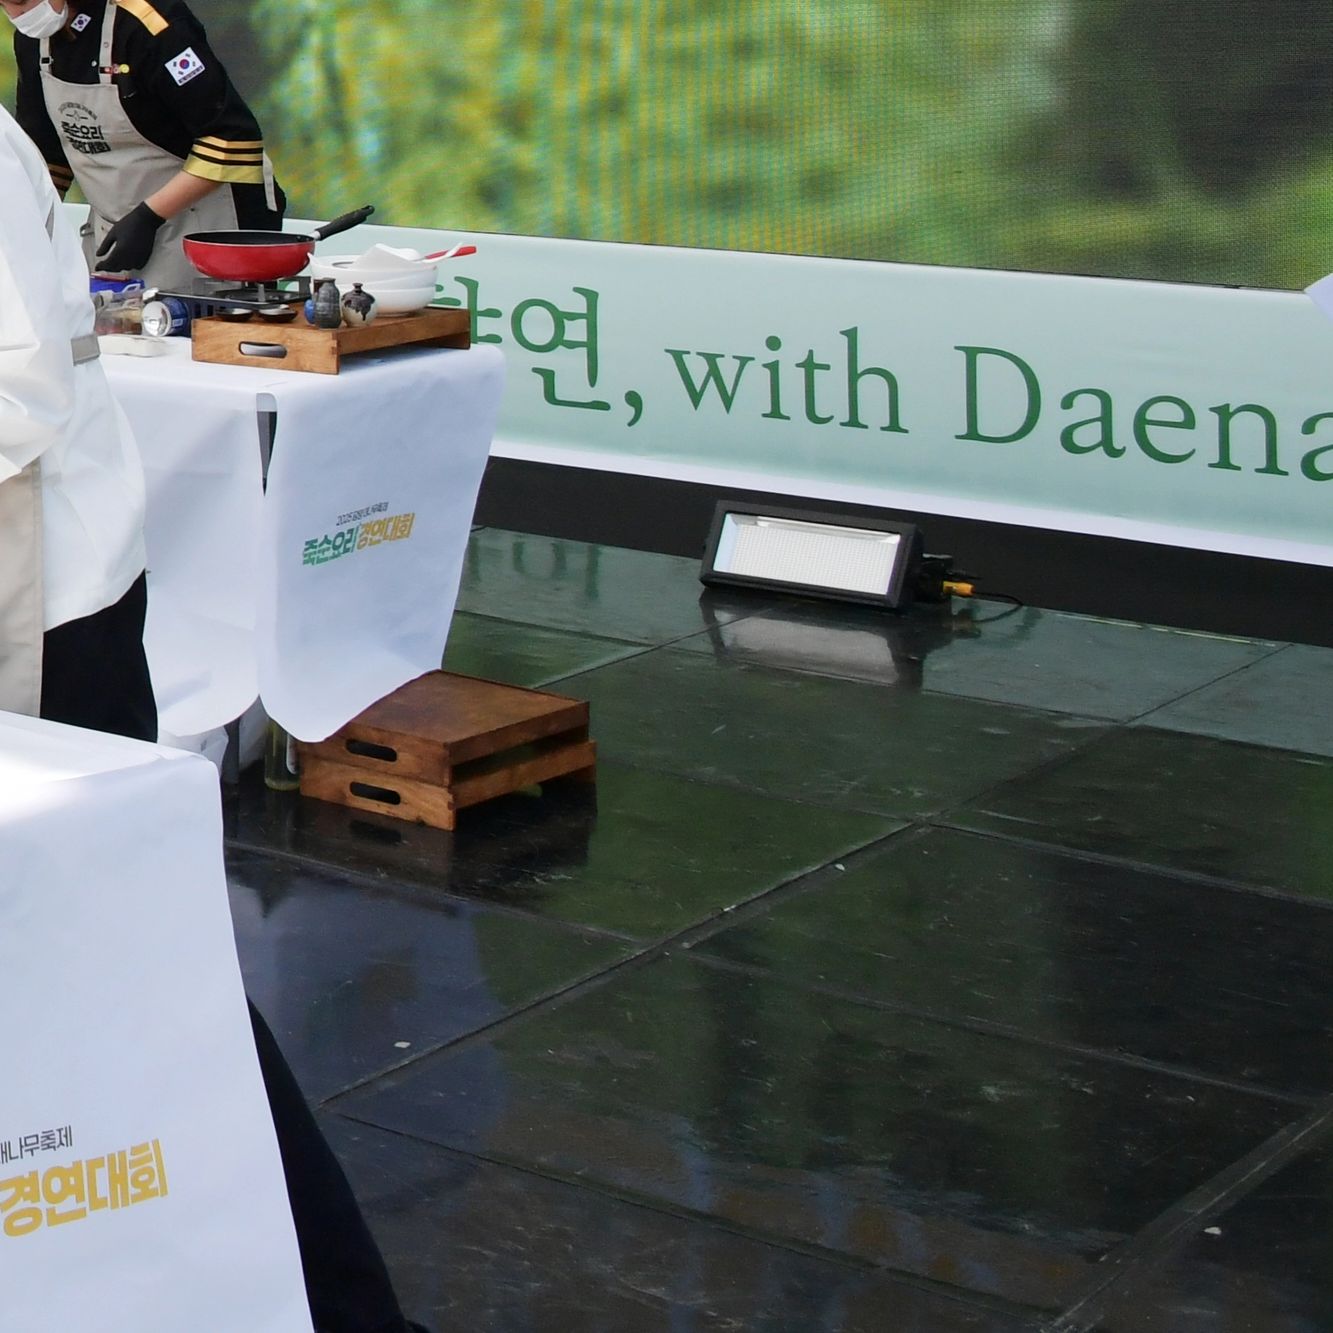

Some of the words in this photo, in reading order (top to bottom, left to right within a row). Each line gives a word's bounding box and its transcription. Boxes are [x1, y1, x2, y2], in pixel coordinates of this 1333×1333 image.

[664, 326, 911, 435] with
[302, 525, 360, 566] 죽순요리
[357, 512, 415, 550] 경연대회
